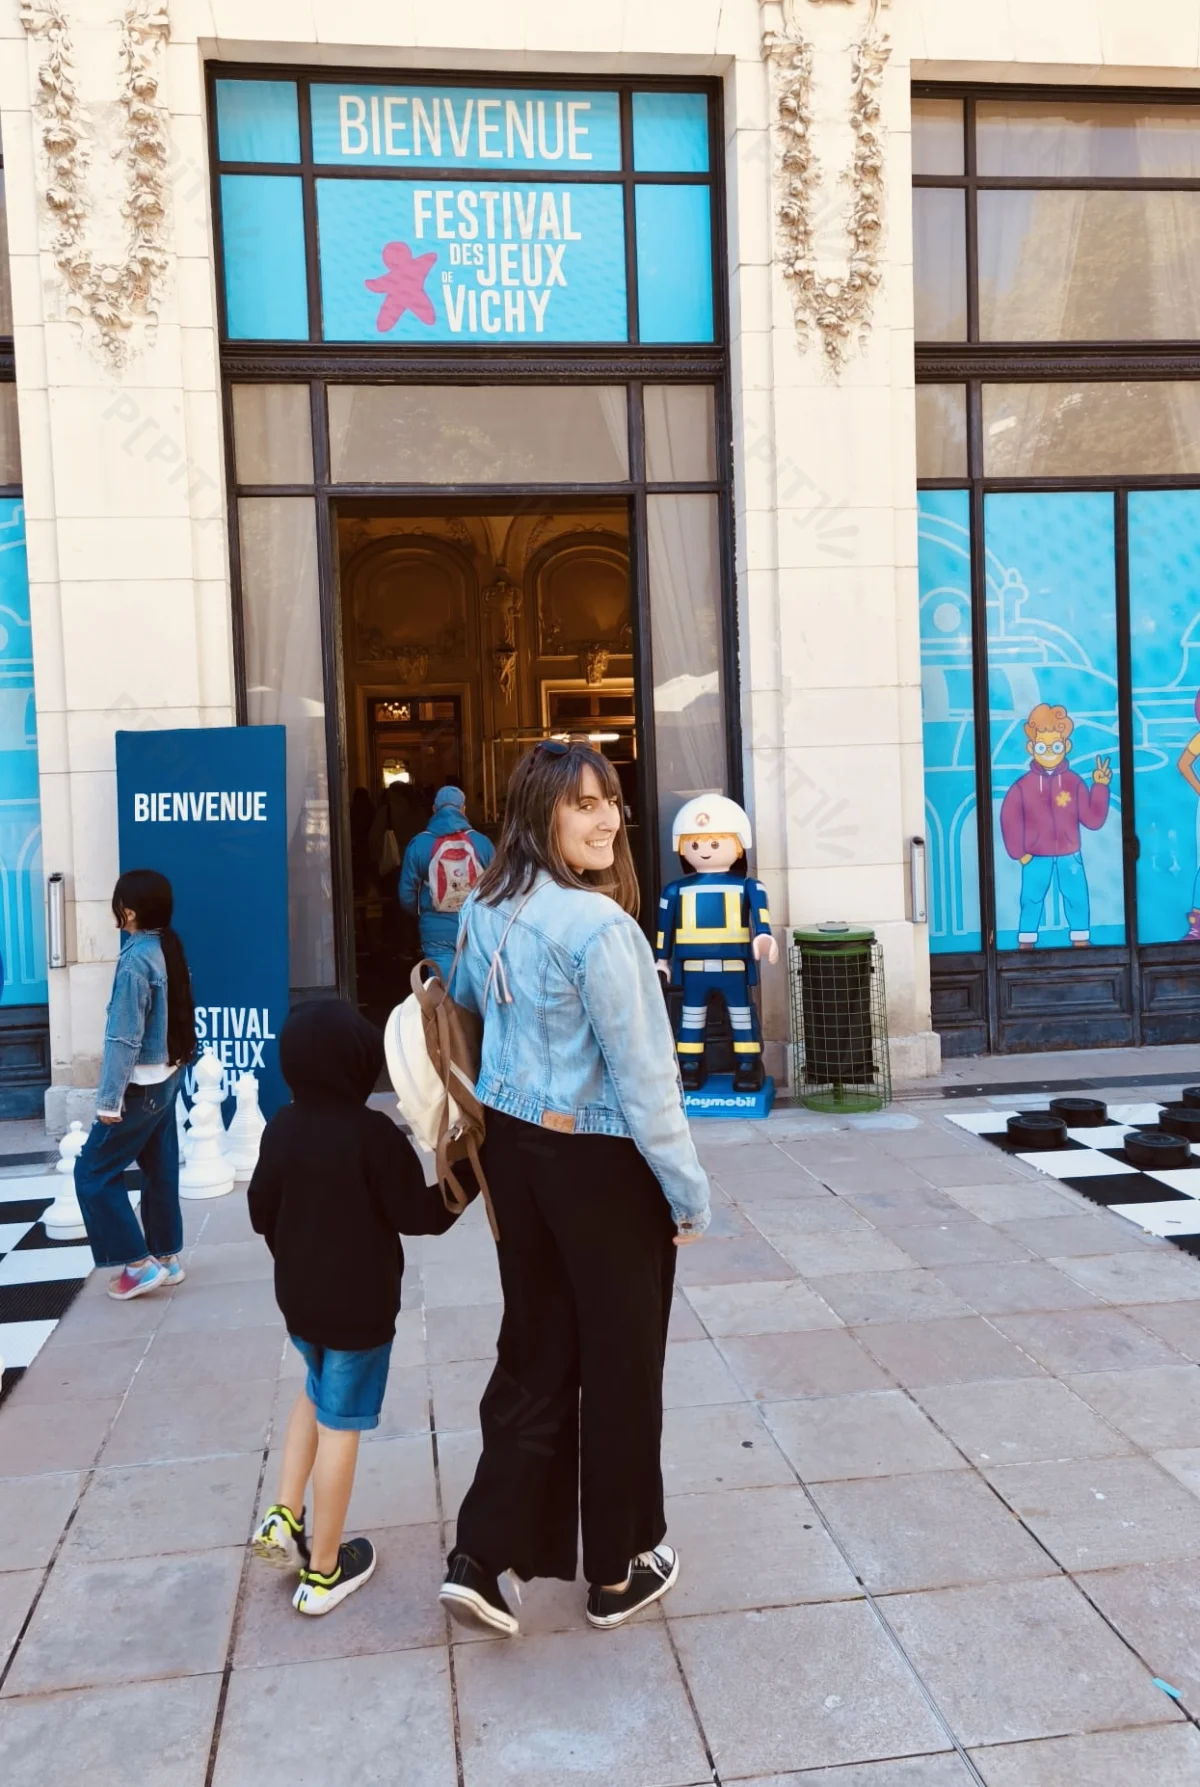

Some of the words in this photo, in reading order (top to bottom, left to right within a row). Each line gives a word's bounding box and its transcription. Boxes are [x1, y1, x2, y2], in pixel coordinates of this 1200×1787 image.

[338, 94, 593, 161] BIENVENUE
[413, 189, 582, 241] FESTIVAL
[441, 270, 454, 284] DE
[449, 242, 484, 266] DES
[476, 243, 568, 288] JEUX
[442, 284, 552, 333] VICHY
[133, 790, 268, 823] BIENVENUE
[194, 1006, 276, 1039] STIVAL
[685, 1095, 756, 1109] laymobil
